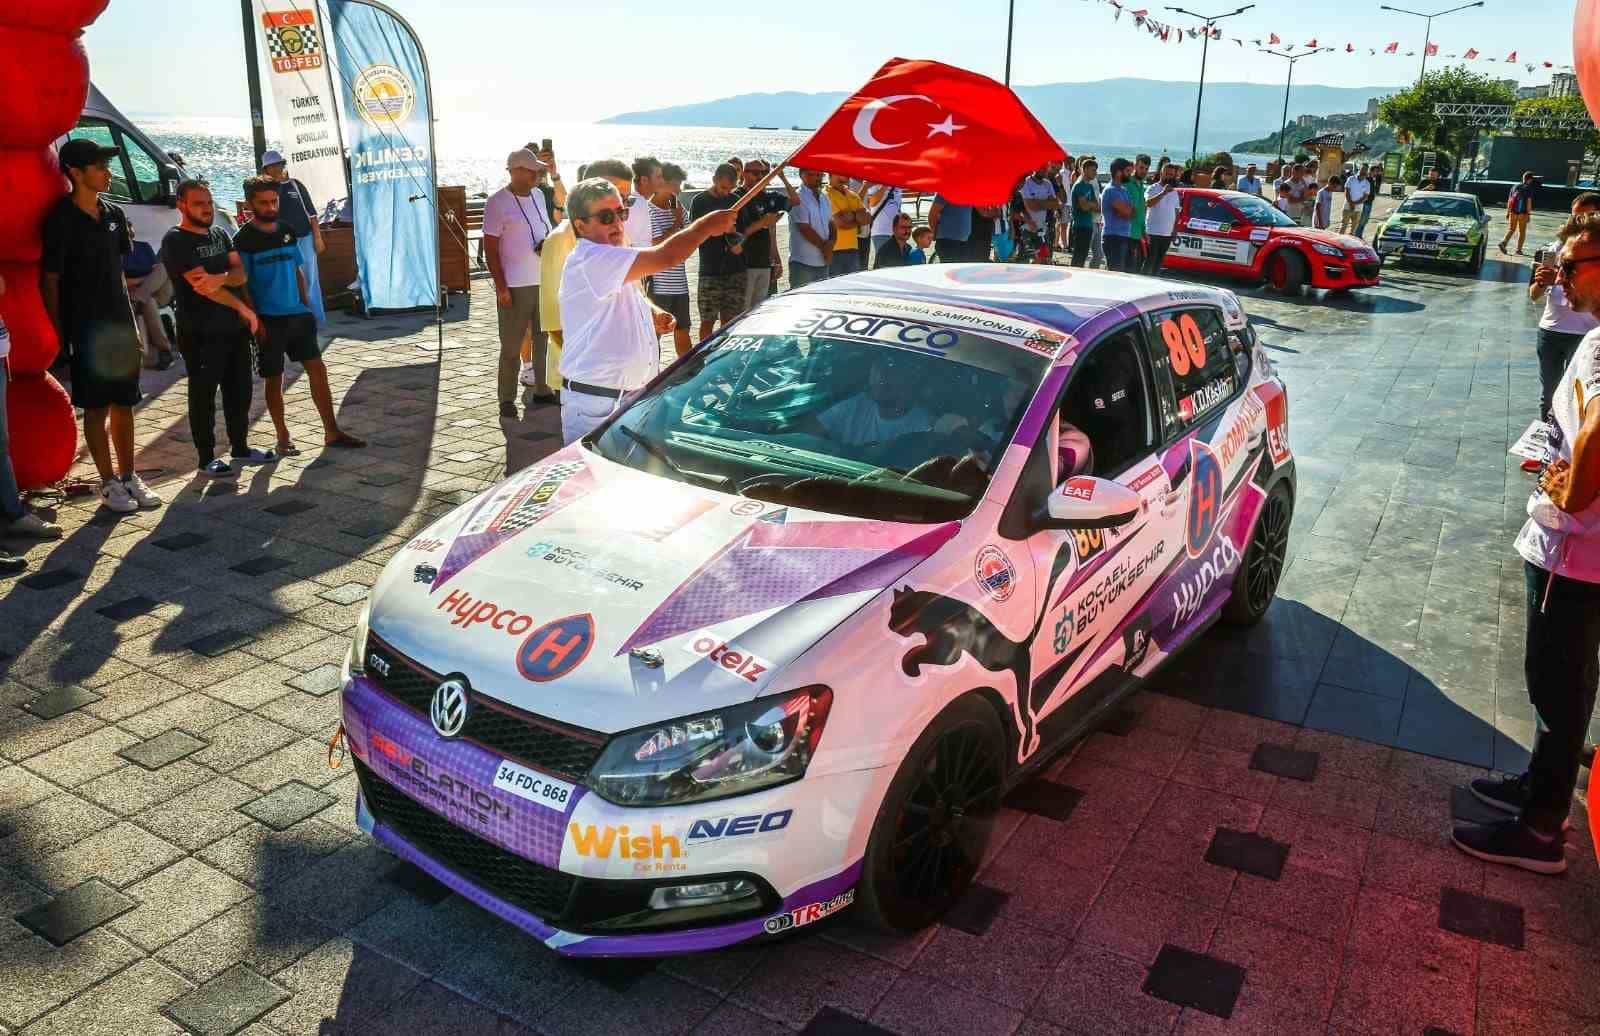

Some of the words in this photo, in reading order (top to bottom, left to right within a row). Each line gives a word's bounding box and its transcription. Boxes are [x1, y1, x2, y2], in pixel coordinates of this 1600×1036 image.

[1162, 313, 1206, 376] 80
[1064, 486, 1092, 500] EAE
[438, 589, 533, 635] Hypco
[498, 767, 515, 783] 34
[515, 774, 542, 793] FDC
[542, 784, 568, 803] 868
[688, 808, 793, 839] NEO
